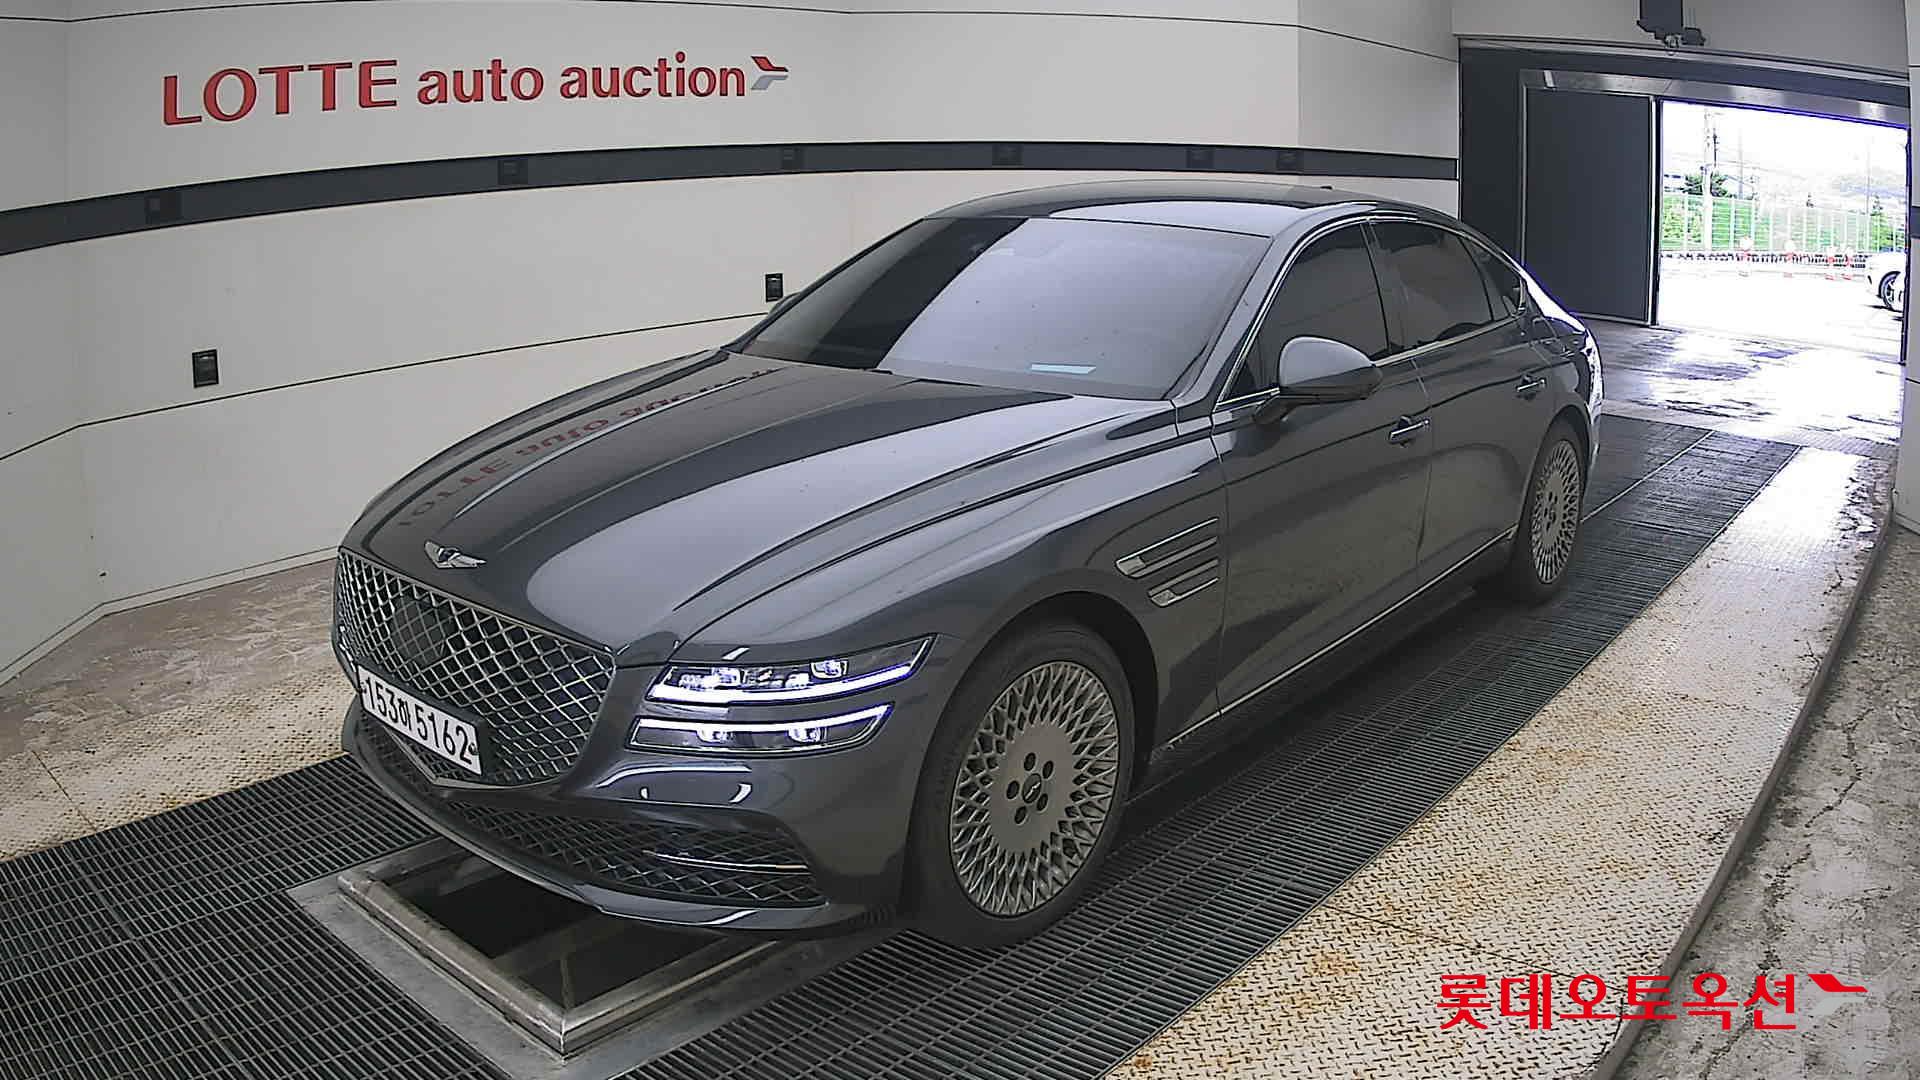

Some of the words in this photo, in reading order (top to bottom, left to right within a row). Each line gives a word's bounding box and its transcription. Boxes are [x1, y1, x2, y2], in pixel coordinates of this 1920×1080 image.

[162, 58, 397, 127] LOTTE
[416, 58, 545, 105] auto
[559, 51, 747, 99] auction
[415, 704, 473, 765] 5162
